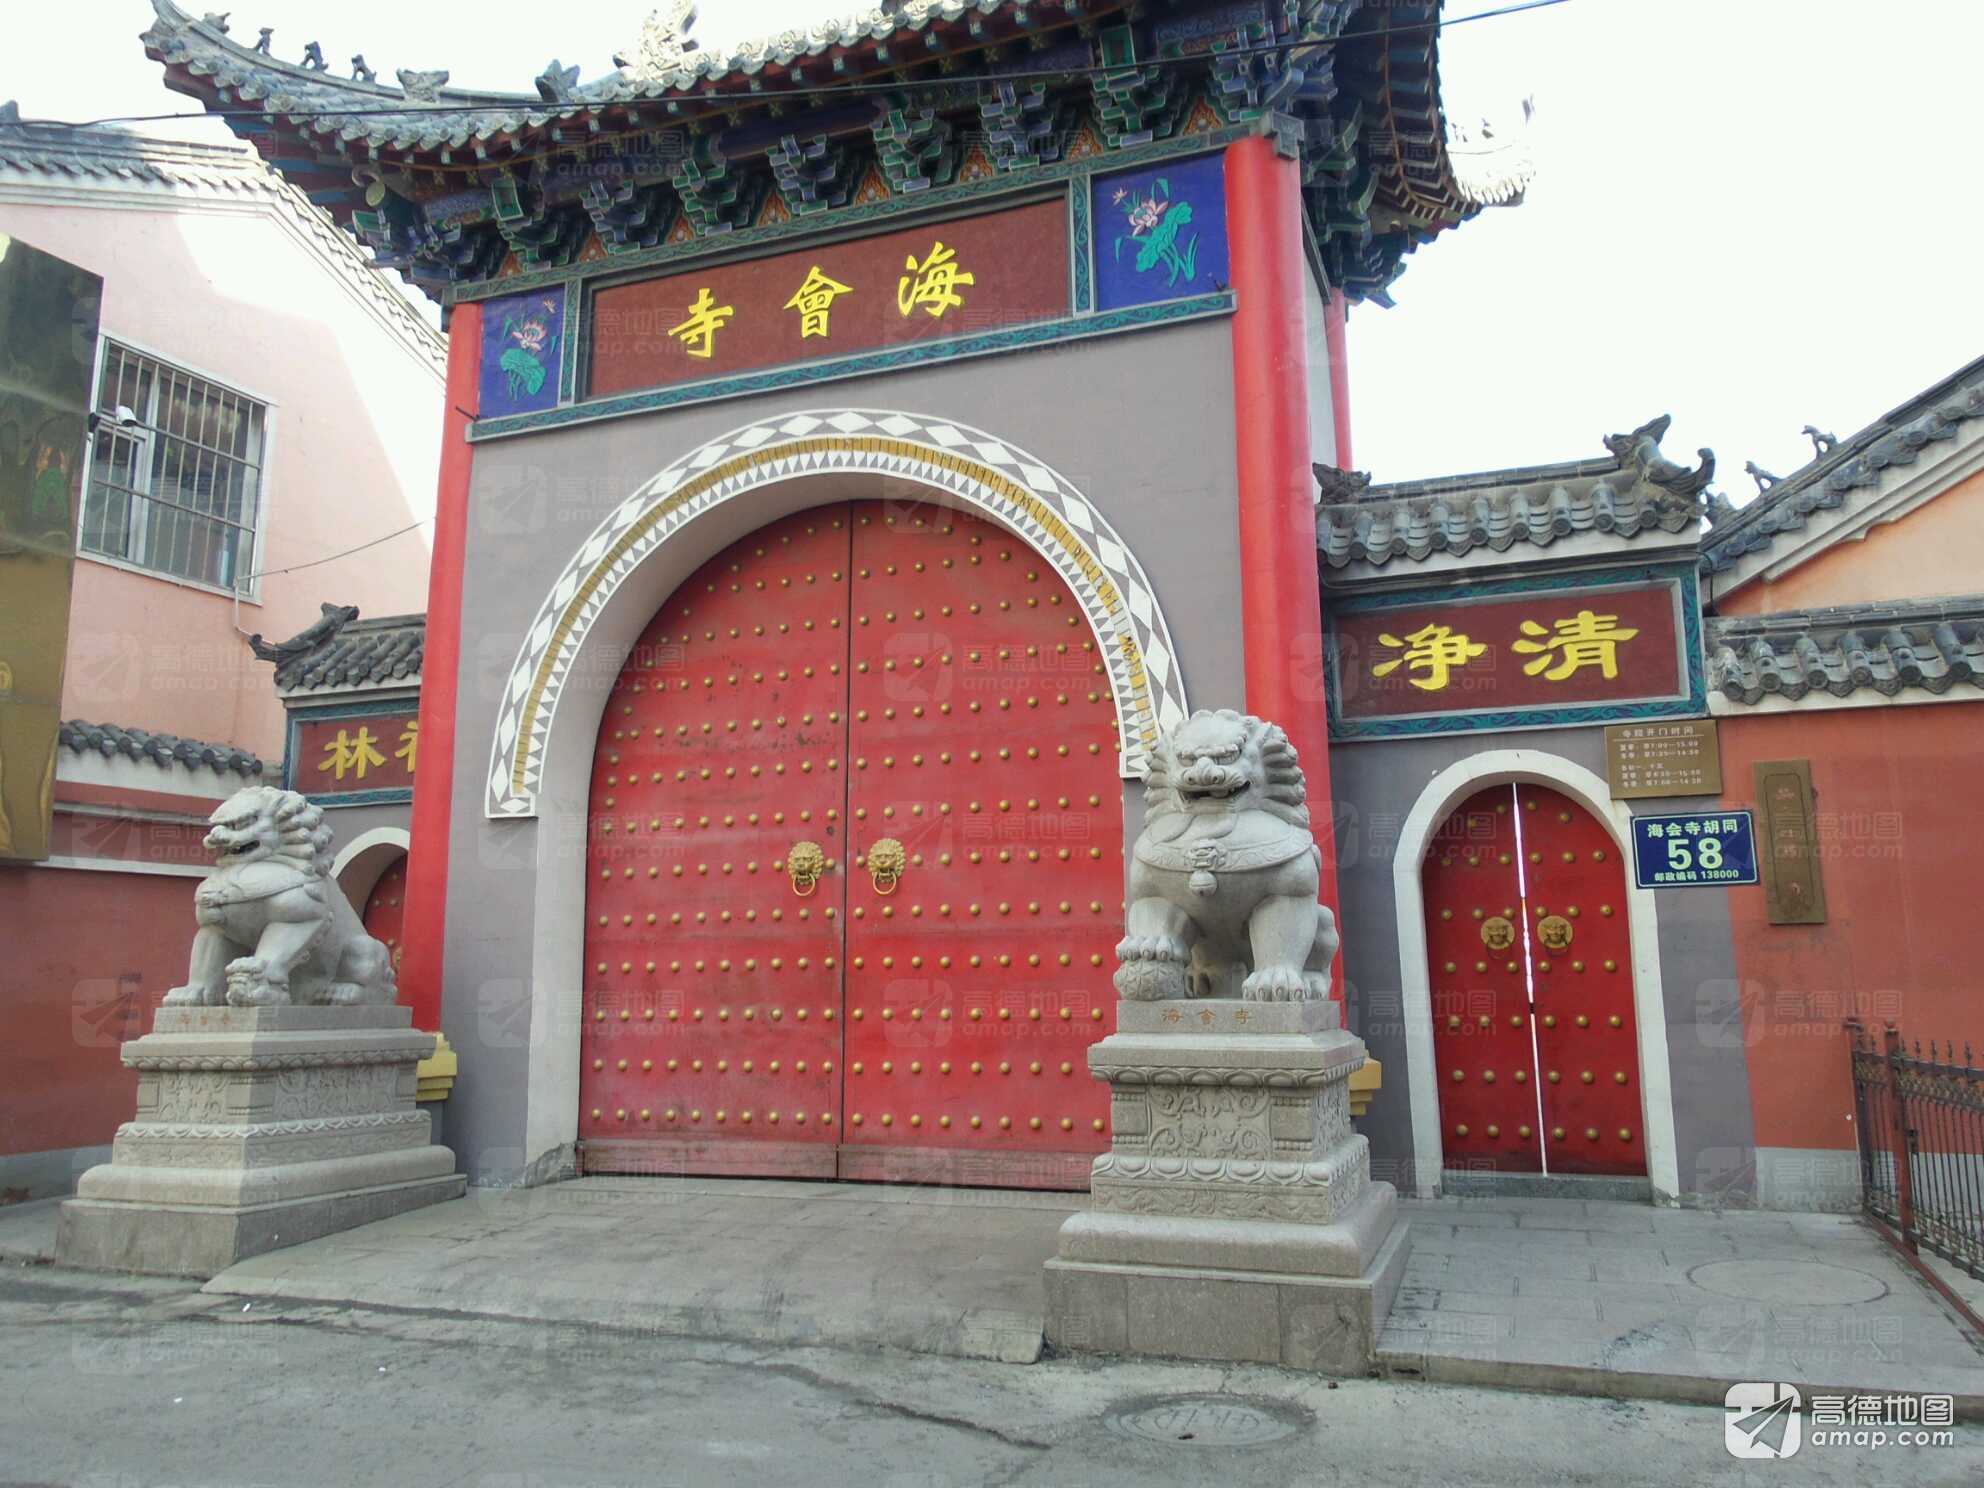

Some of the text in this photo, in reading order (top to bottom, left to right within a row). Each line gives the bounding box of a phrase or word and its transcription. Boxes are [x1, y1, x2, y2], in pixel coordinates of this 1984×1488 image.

[1647, 819, 1738, 838] 海会寺胡同
[1668, 837, 1723, 870] 58
[1654, 869, 1739, 881] 邮政编码 138000
